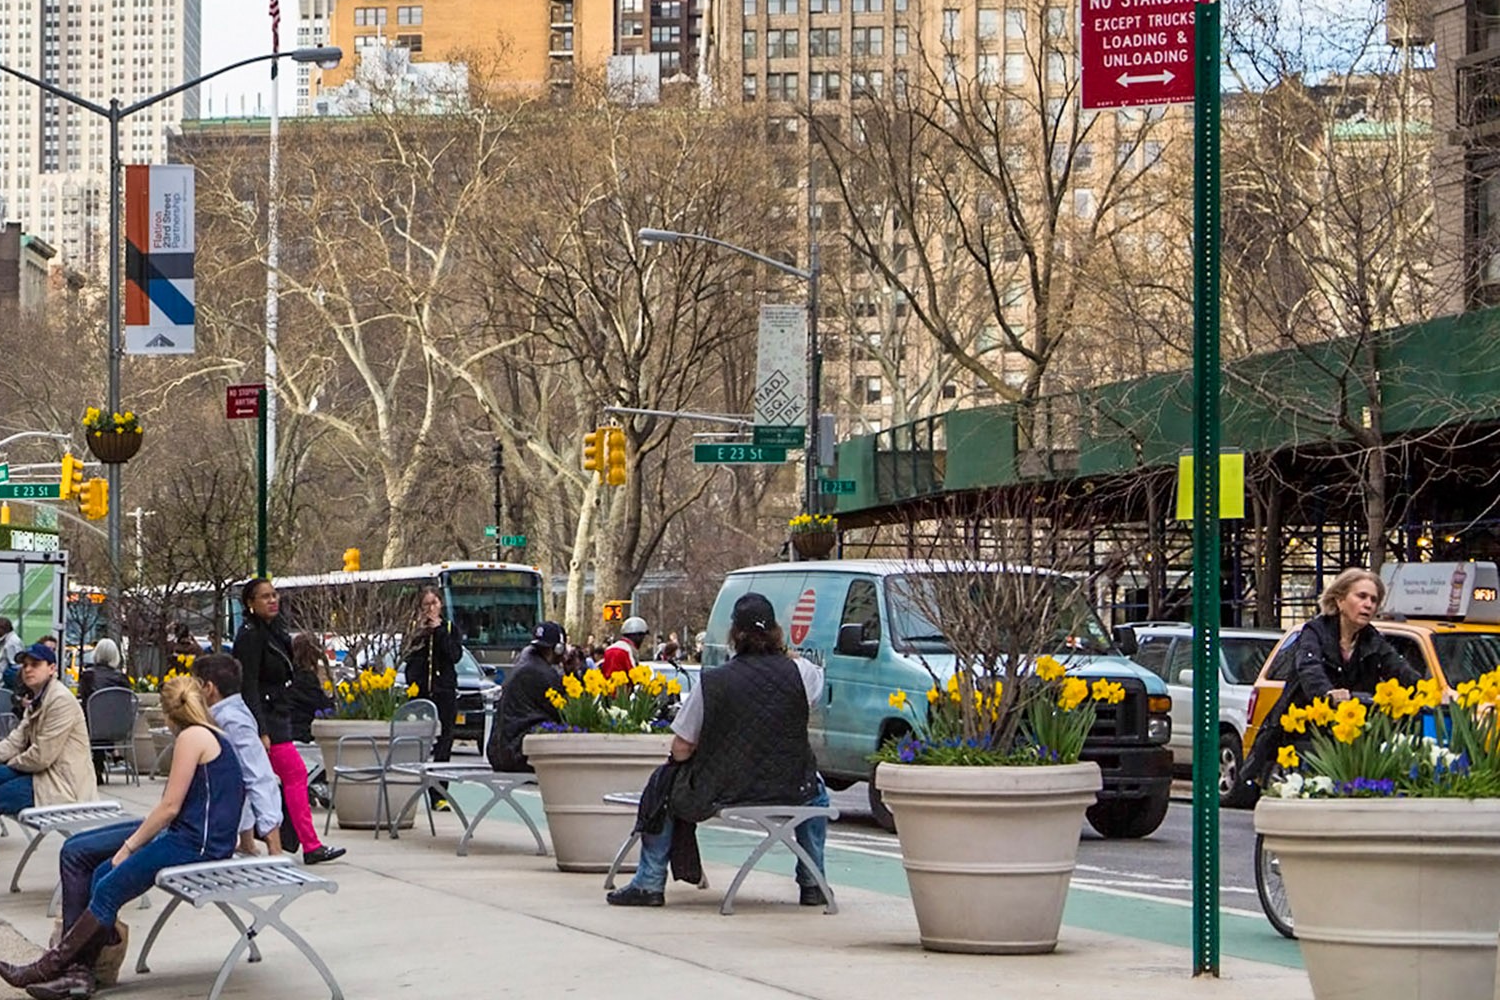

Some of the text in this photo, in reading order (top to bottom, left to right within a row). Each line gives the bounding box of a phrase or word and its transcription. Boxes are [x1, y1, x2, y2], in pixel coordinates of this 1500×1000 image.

[1095, 11, 1195, 32] EXCEPT TRUCKS
[1102, 31, 1188, 49] LOADING &
[1103, 49, 1188, 68] UNLOADING
[154, 211, 162, 249] Flatiron
[163, 193, 171, 249] 23rd Street
[172, 193, 181, 249] Partnership
[765, 398, 787, 417] SQ.
[718, 447, 762, 460] E 23 St
[13, 486, 48, 496] E 23 St
